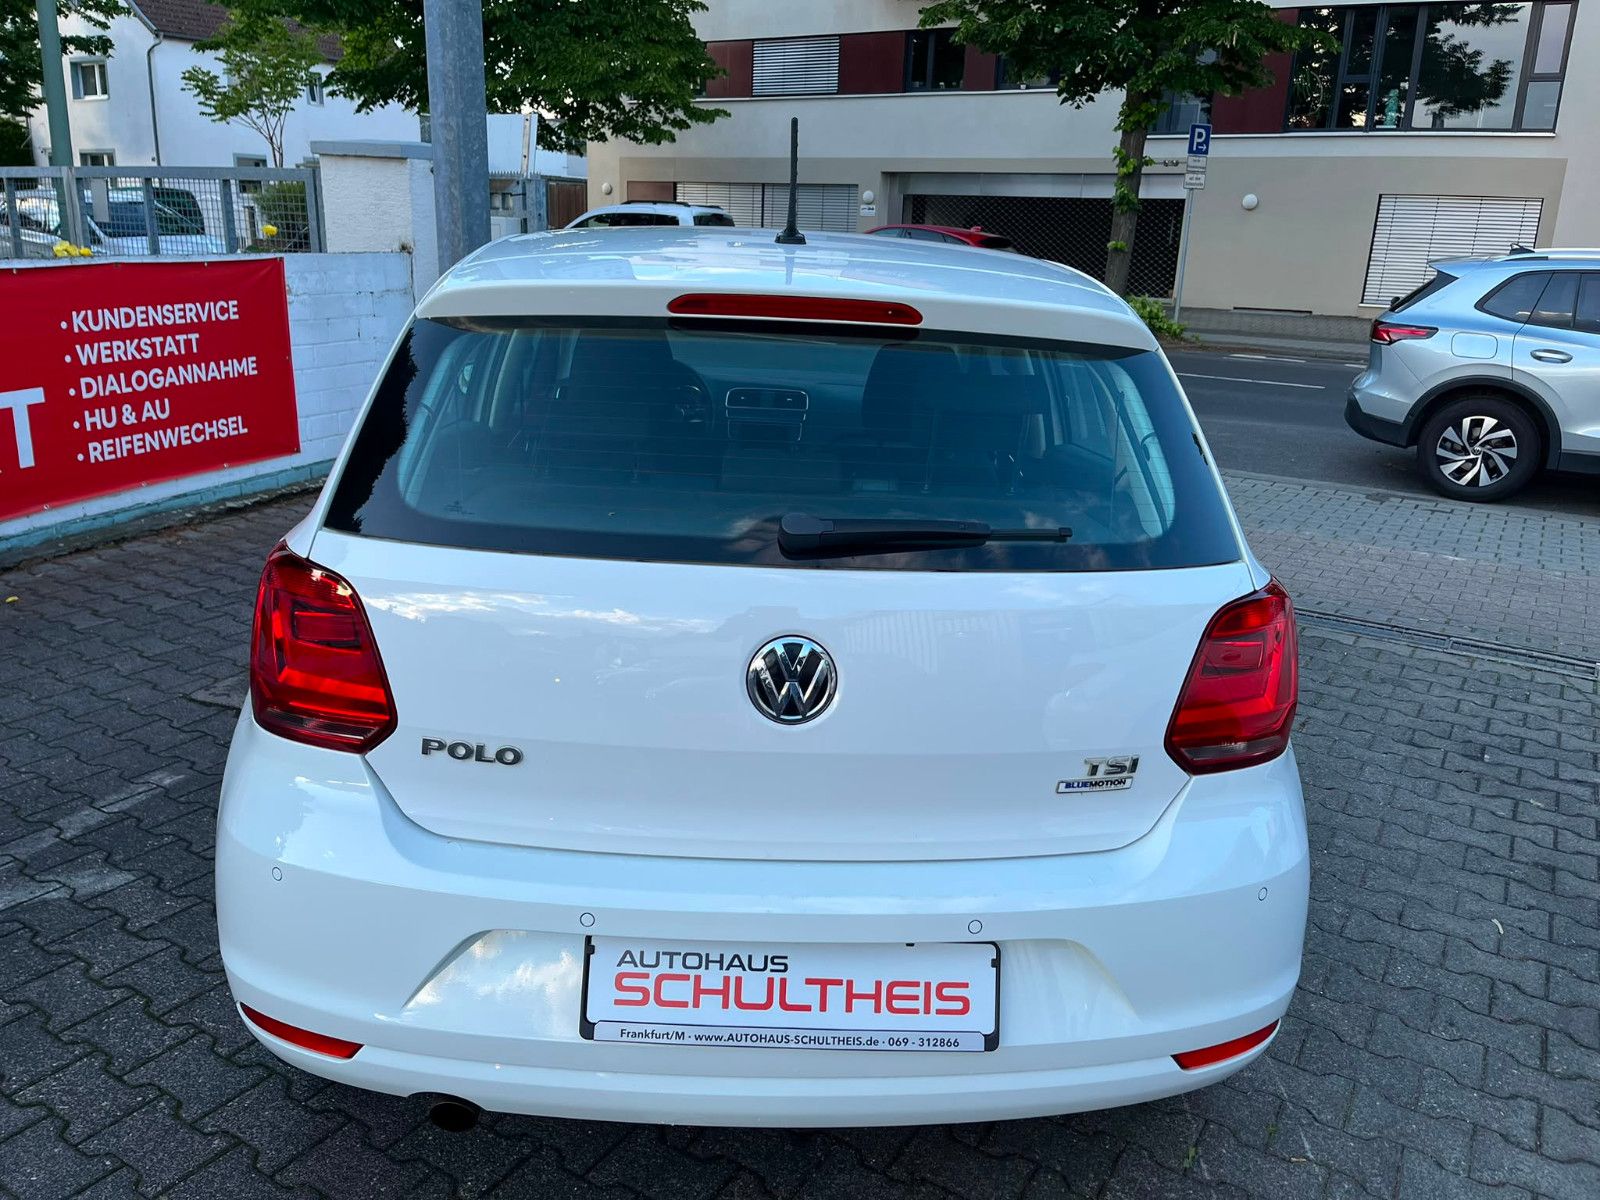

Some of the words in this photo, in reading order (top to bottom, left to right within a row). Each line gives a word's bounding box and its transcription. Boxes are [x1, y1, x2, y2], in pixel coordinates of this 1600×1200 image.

[1193, 128, 1206, 151] P
[72, 300, 239, 333] KUNDENSERVICE
[75, 333, 200, 366] WERKSTATT
[80, 356, 258, 399] DIALOGANNAHME
[84, 406, 117, 432] HU
[121, 403, 137, 425] &
[141, 398, 170, 422] AU
[88, 415, 248, 464] REIFENWECHSEL
[421, 736, 524, 766] POLO
[1084, 755, 1139, 777] TSI
[1065, 779, 1126, 789] BLUEMOTION
[616, 949, 789, 973] AUTOHAUS
[613, 971, 971, 1016] SCHULTHEIS
[620, 1028, 685, 1041] Frankfurt/M
[694, 1033, 879, 1046] www.AUTOHAUS-SCHULTHEIS.de
[888, 1038, 909, 1047] 069
[918, 1038, 960, 1048] 312866
